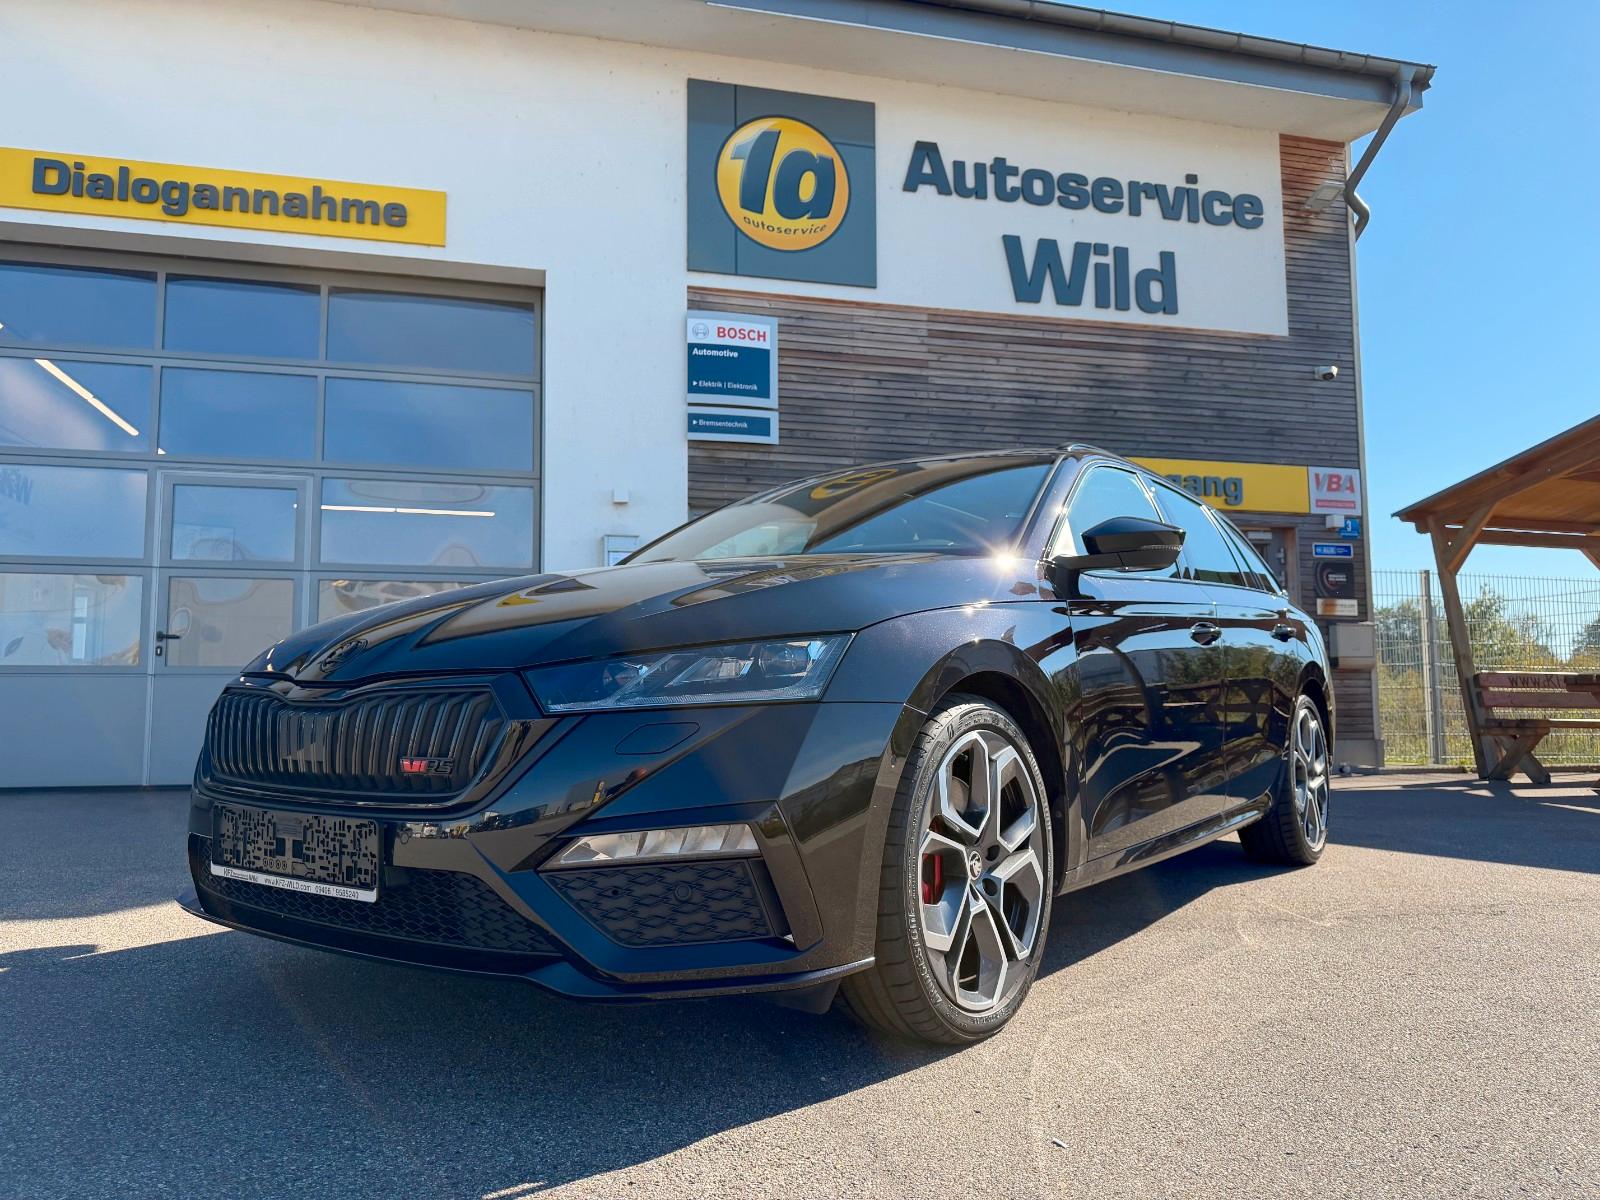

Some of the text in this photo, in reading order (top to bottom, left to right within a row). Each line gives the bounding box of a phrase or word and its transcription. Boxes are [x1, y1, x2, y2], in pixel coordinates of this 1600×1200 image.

[32, 157, 408, 227] Dialogannahme
[902, 140, 1265, 230] Autoservice
[743, 215, 828, 236] autoservice
[1002, 234, 1179, 316] Wild
[716, 326, 767, 342] BOSCH
[692, 347, 738, 358] Automotive
[698, 380, 722, 389] Elektrik
[727, 382, 758, 391] Elektronik
[698, 419, 748, 428] Bremsentechnik
[1314, 472, 1356, 494] VBA
[1346, 519, 1352, 532] 3
